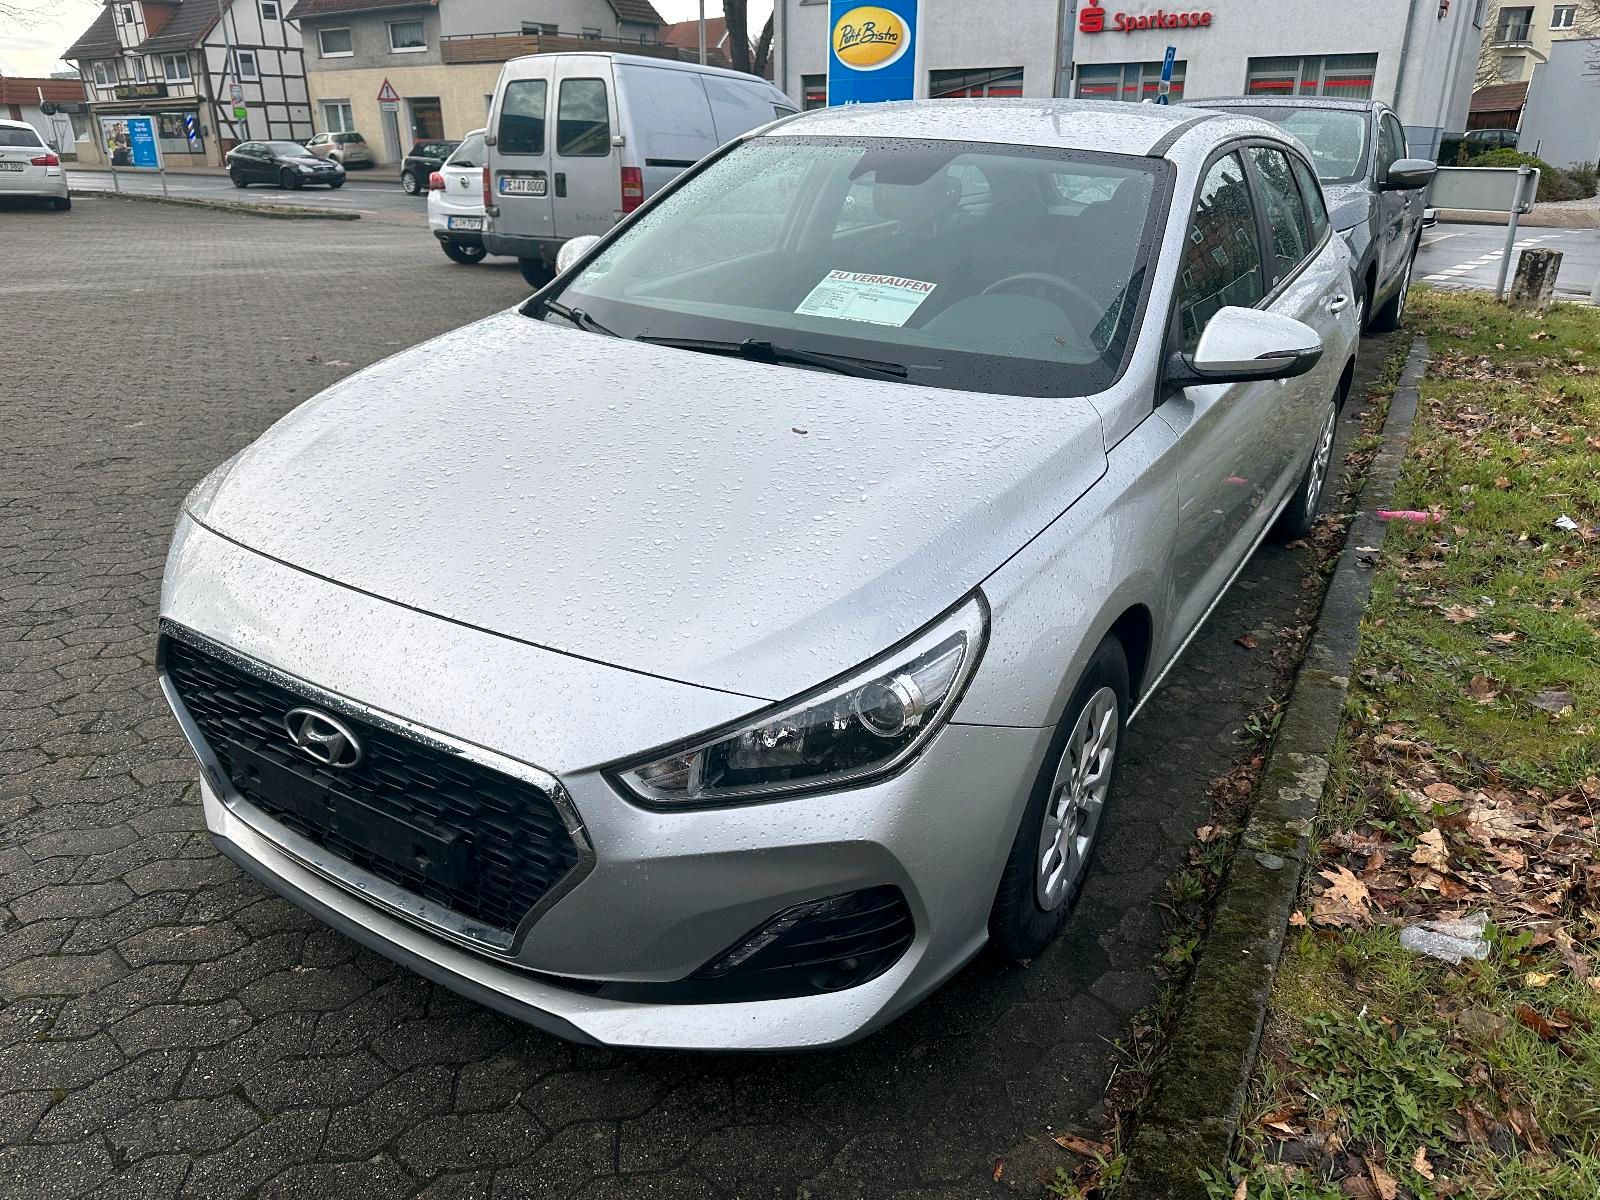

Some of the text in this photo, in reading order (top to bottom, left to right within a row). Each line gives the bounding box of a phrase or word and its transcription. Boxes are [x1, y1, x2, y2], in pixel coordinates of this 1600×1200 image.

[1114, 9, 1213, 33] Sparkasse
[840, 21, 899, 48] Petit Bistro
[1165, 50, 1173, 70] P
[527, 180, 545, 192] 8000
[829, 271, 850, 280] ZU
[851, 273, 933, 292] VERKAUFEN
